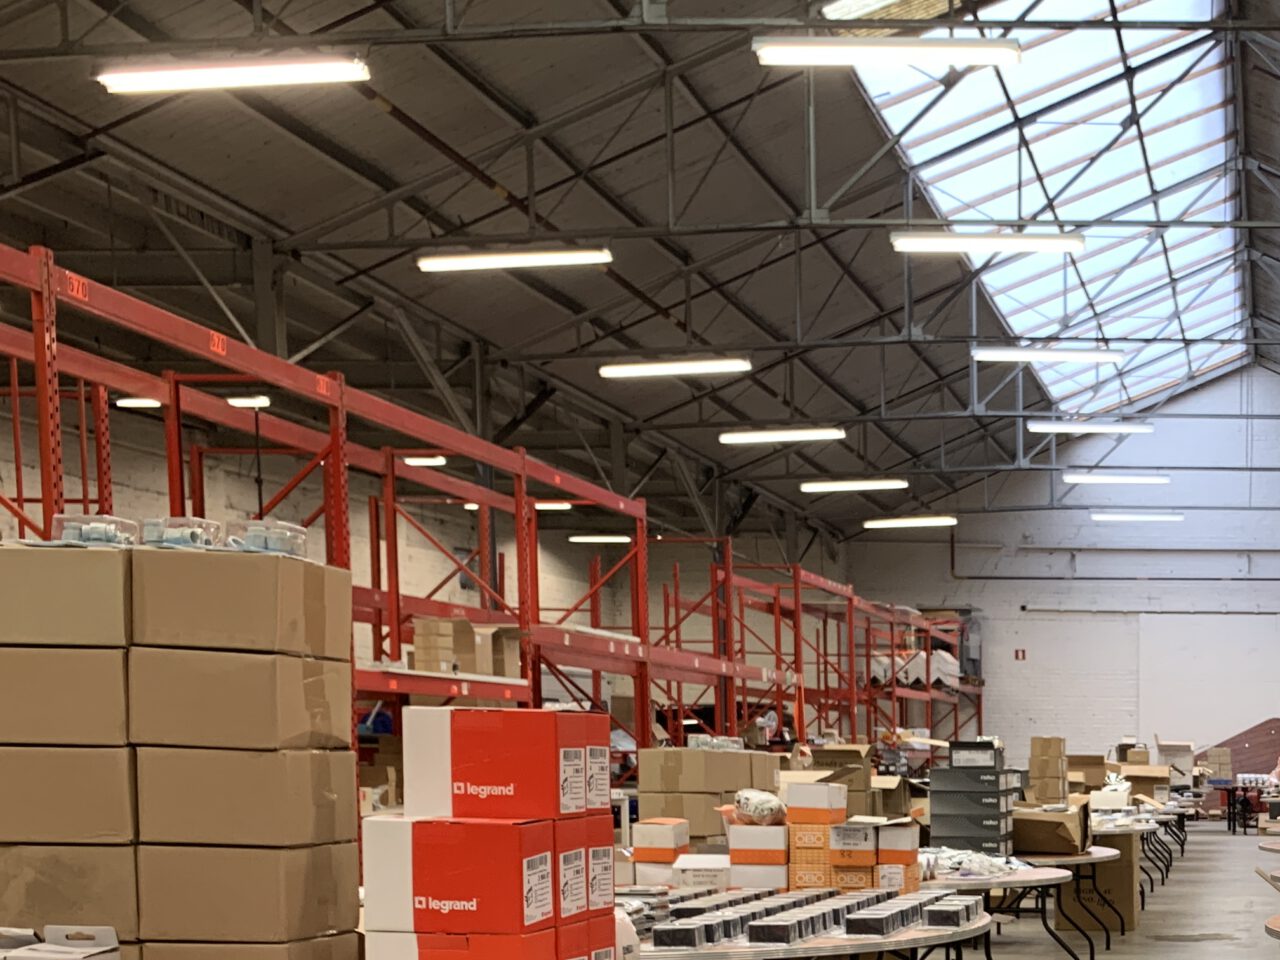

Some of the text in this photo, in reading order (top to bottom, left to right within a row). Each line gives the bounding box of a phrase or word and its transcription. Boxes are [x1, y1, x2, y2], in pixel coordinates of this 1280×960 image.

[466, 782, 515, 799] legrand
[795, 833, 825, 844] OBO
[796, 872, 825, 883] OBO
[428, 897, 478, 914] legrand
